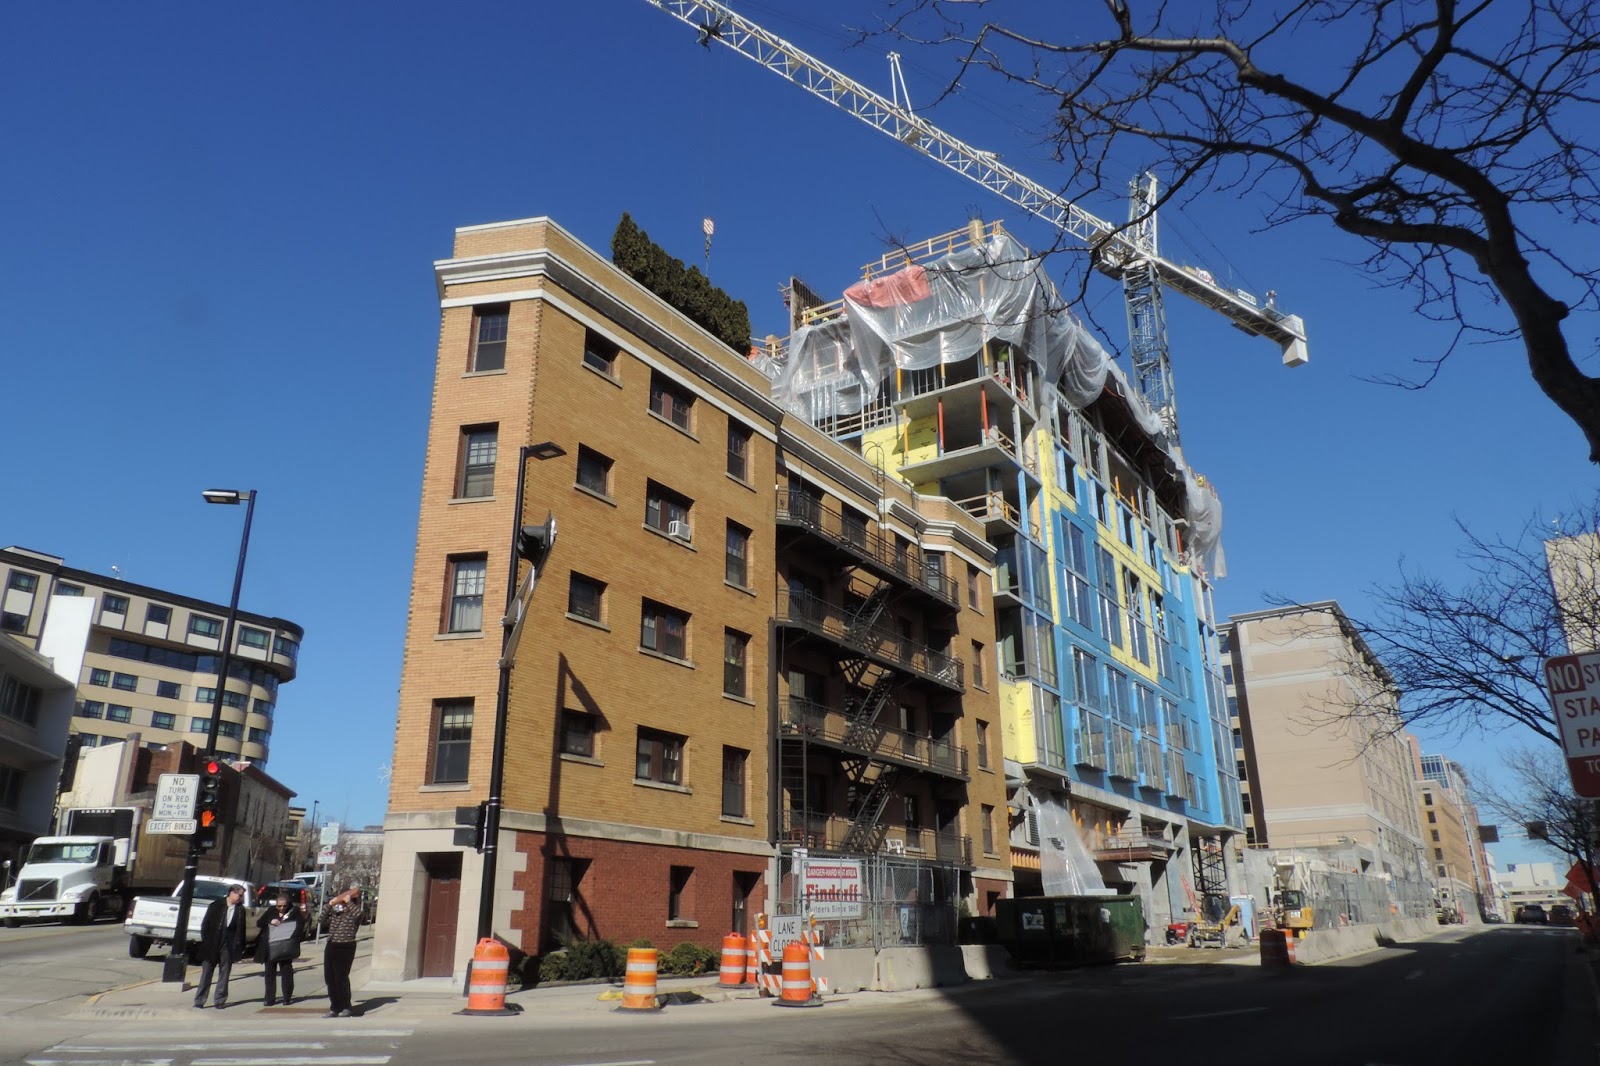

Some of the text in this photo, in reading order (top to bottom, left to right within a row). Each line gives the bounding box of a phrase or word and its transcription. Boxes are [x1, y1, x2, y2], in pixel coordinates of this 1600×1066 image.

[1548, 664, 1579, 692] NO
[172, 777, 185, 786] NO
[149, 822, 193, 831] EXCEPT BIKES
[806, 884, 858, 902] Findorff
[778, 921, 795, 934] LANE
